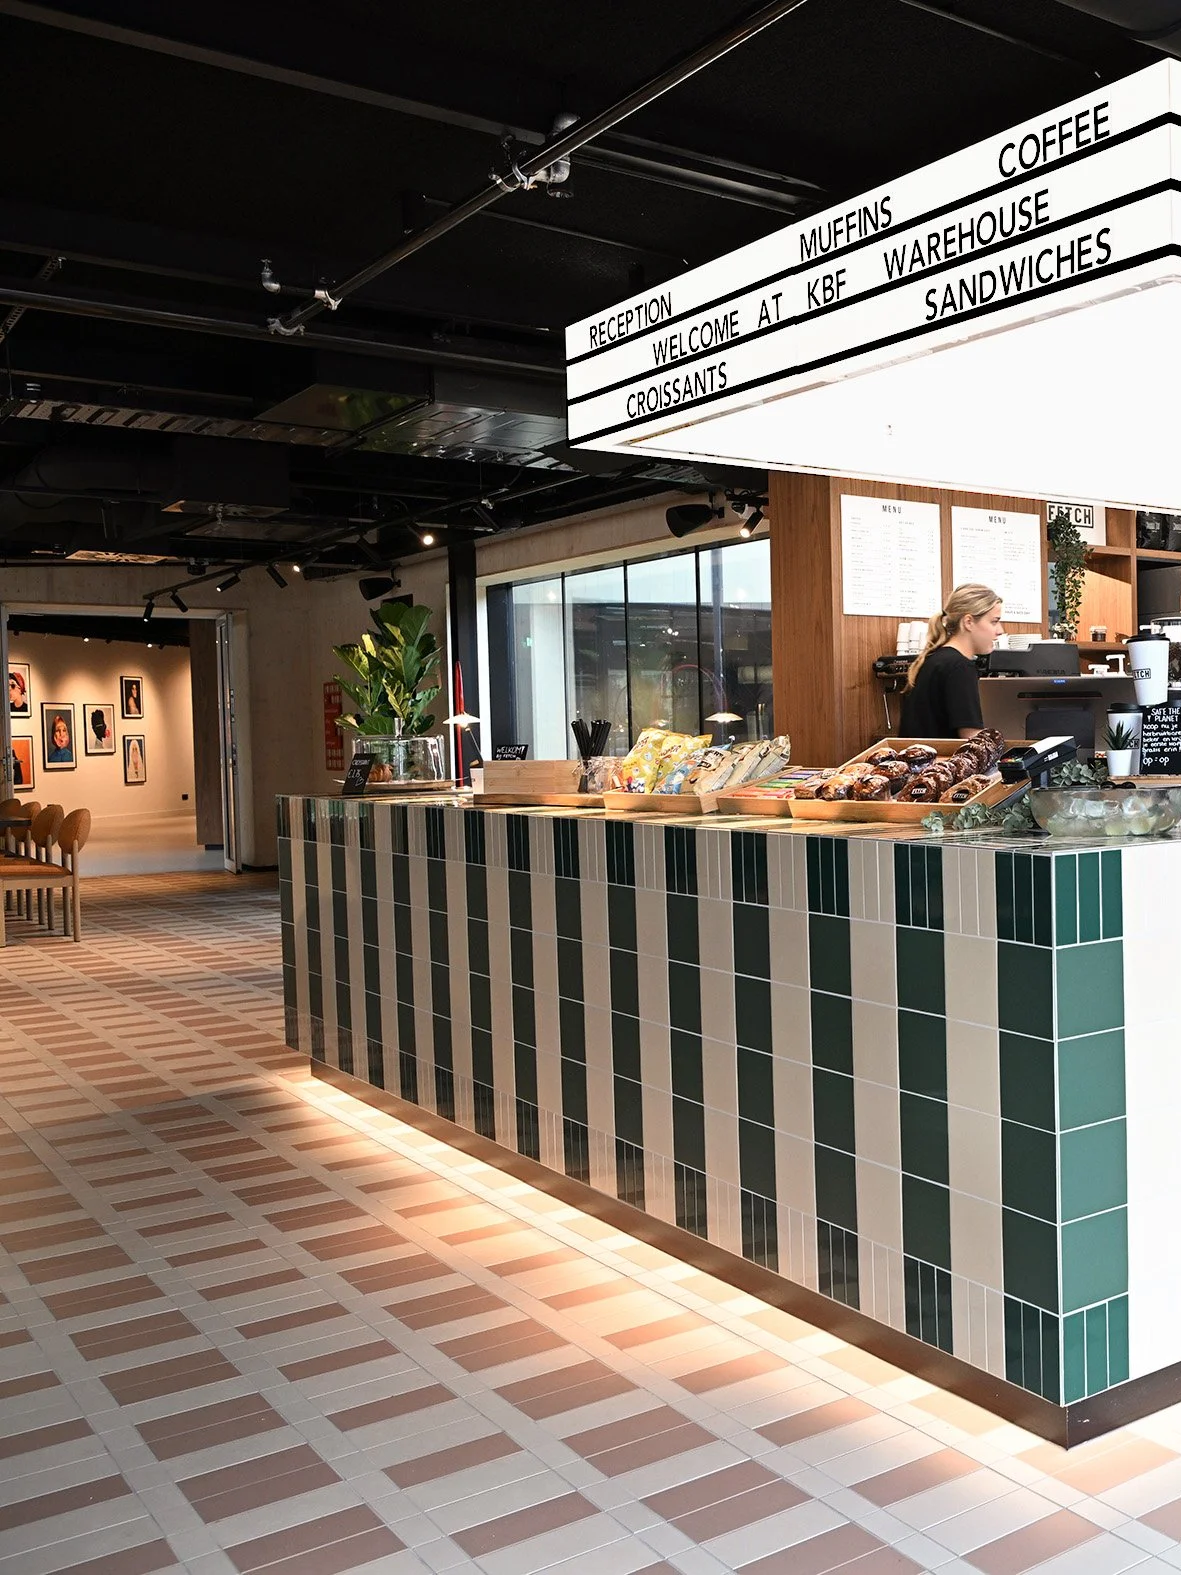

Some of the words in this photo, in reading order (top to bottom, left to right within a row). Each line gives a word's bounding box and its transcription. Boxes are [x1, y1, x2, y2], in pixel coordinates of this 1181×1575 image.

[999, 101, 1110, 178] COFFEE
[800, 196, 893, 262] MUFFINS
[652, 310, 740, 366] WELCOME
[757, 291, 784, 329] AT
[807, 268, 848, 310] KBF
[883, 189, 1051, 281] WAREHOUSE
[925, 227, 1113, 322] SANDWICHES
[589, 292, 673, 349] RECEPTION
[626, 362, 728, 419] CROISSANTS
[882, 504, 902, 514] MENU
[988, 515, 1007, 524] MENU
